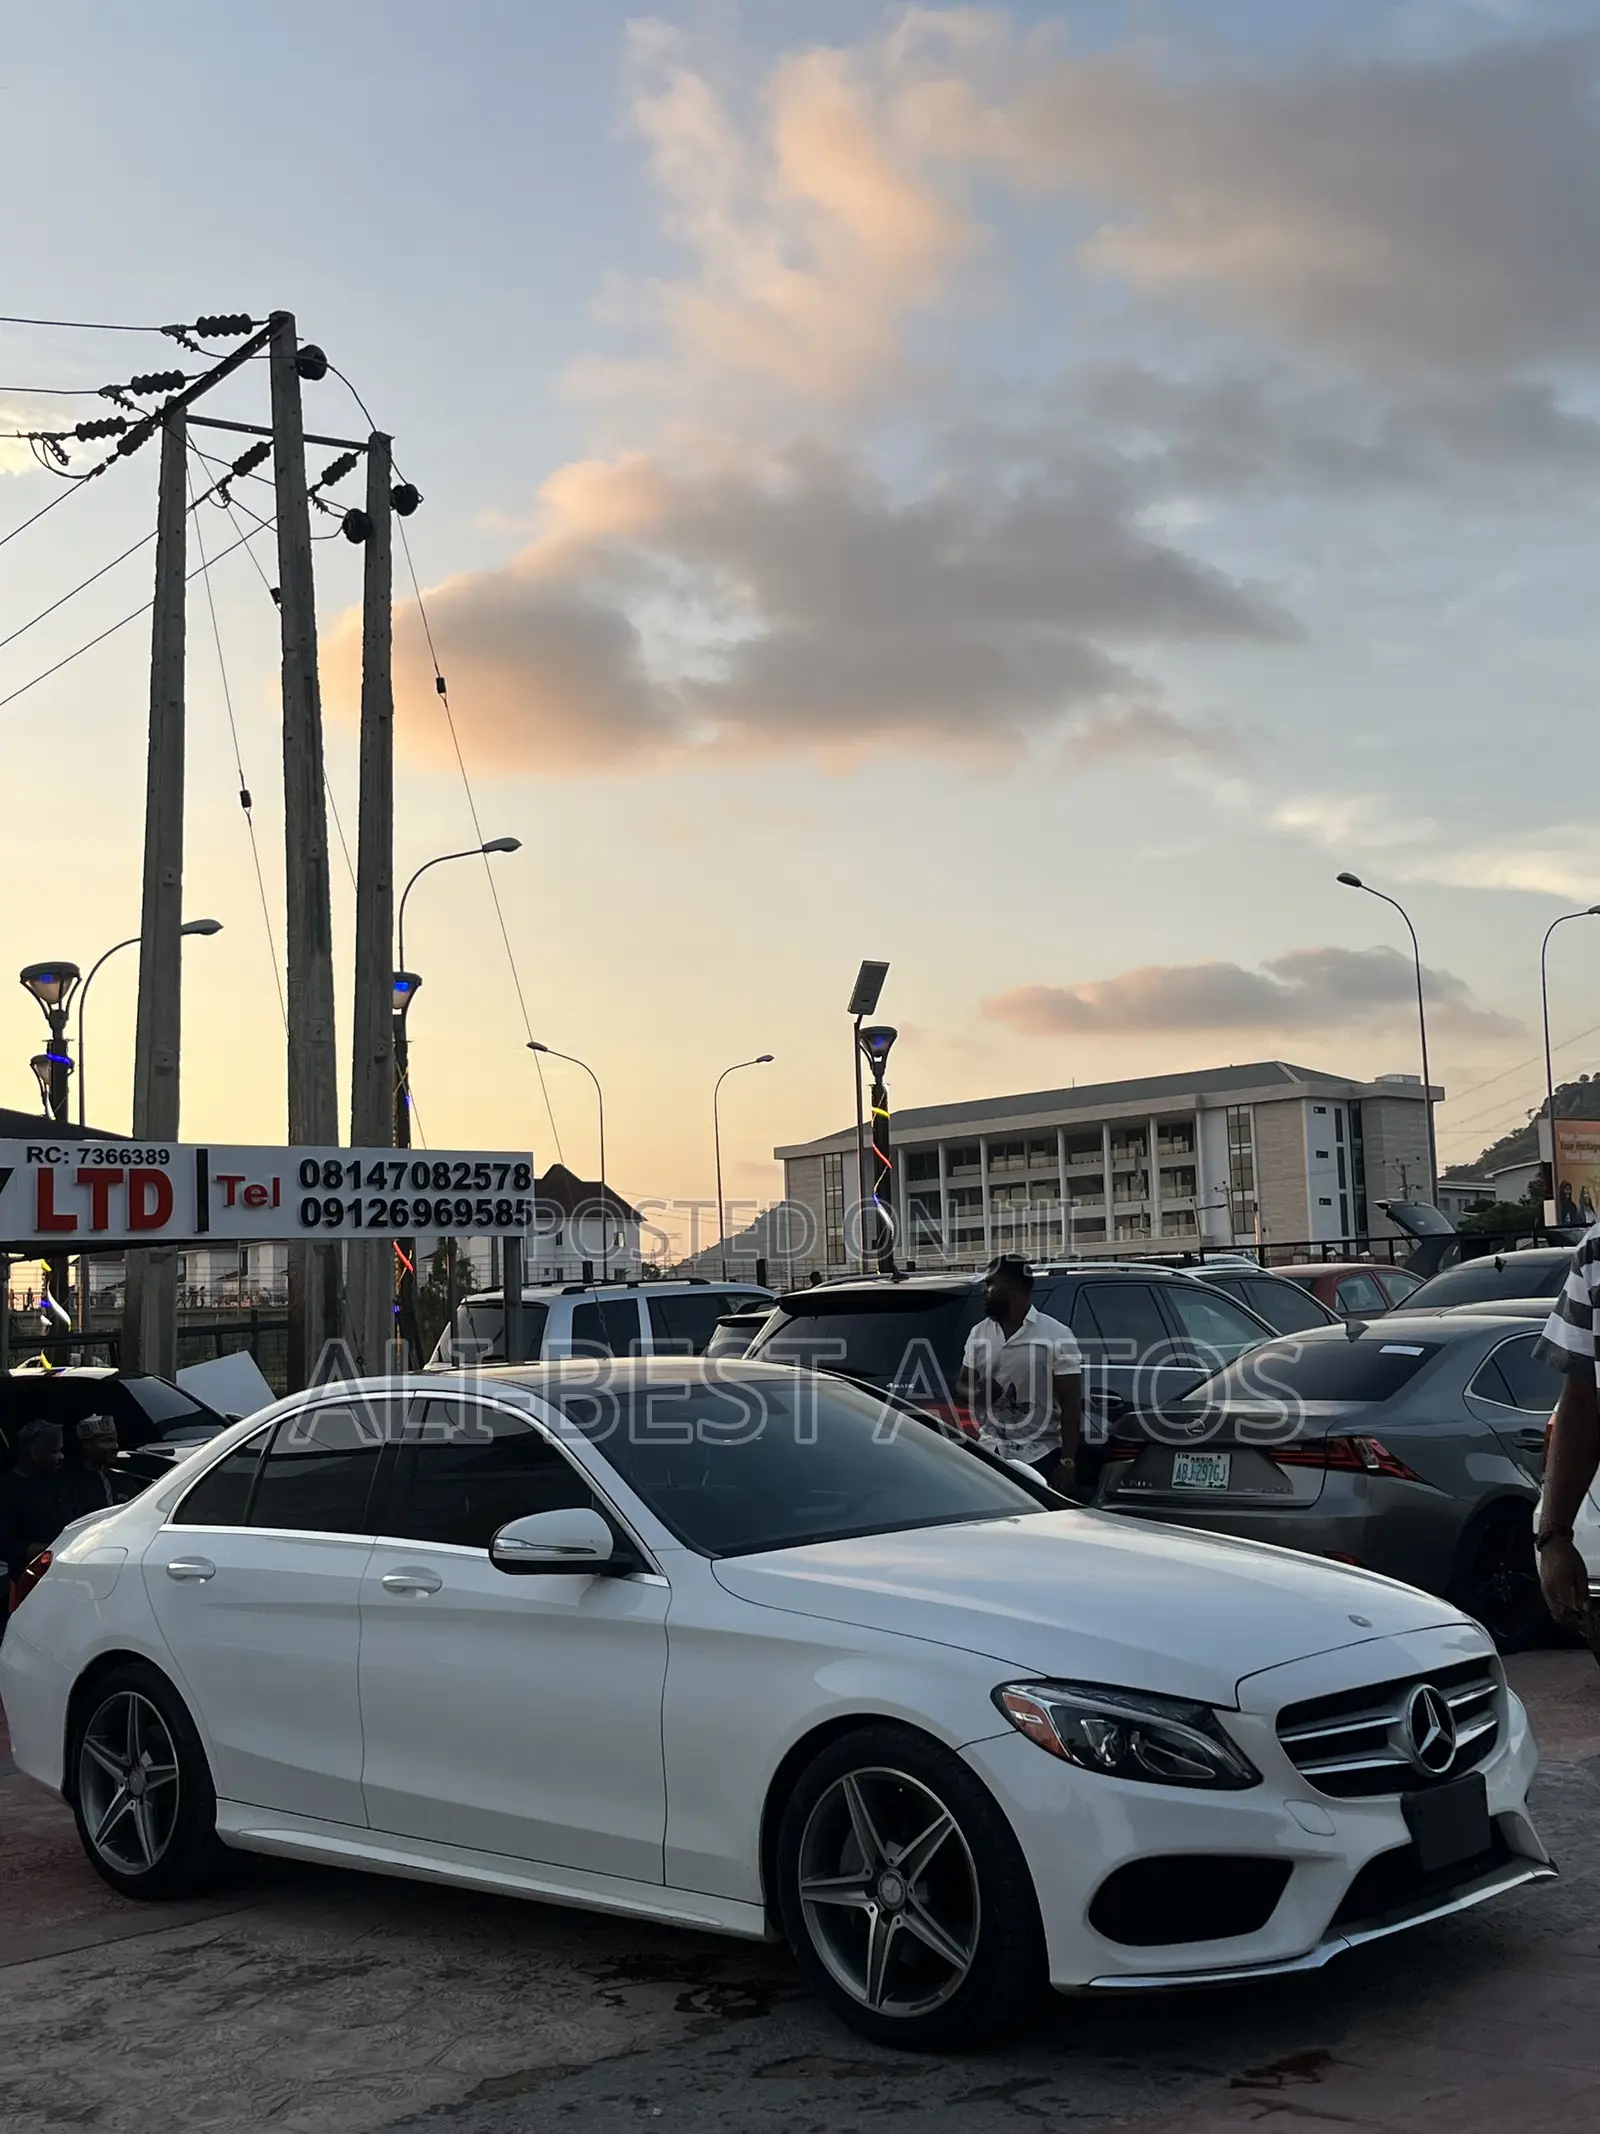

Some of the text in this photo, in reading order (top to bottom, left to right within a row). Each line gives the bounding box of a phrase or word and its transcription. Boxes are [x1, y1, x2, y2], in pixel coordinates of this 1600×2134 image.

[26, 1146, 170, 1165] RC: 7366389
[216, 1174, 281, 1208] Tel
[299, 1158, 531, 1191] 08147082578
[36, 1167, 174, 1232] LTD
[300, 1197, 533, 1229] 09126969585
